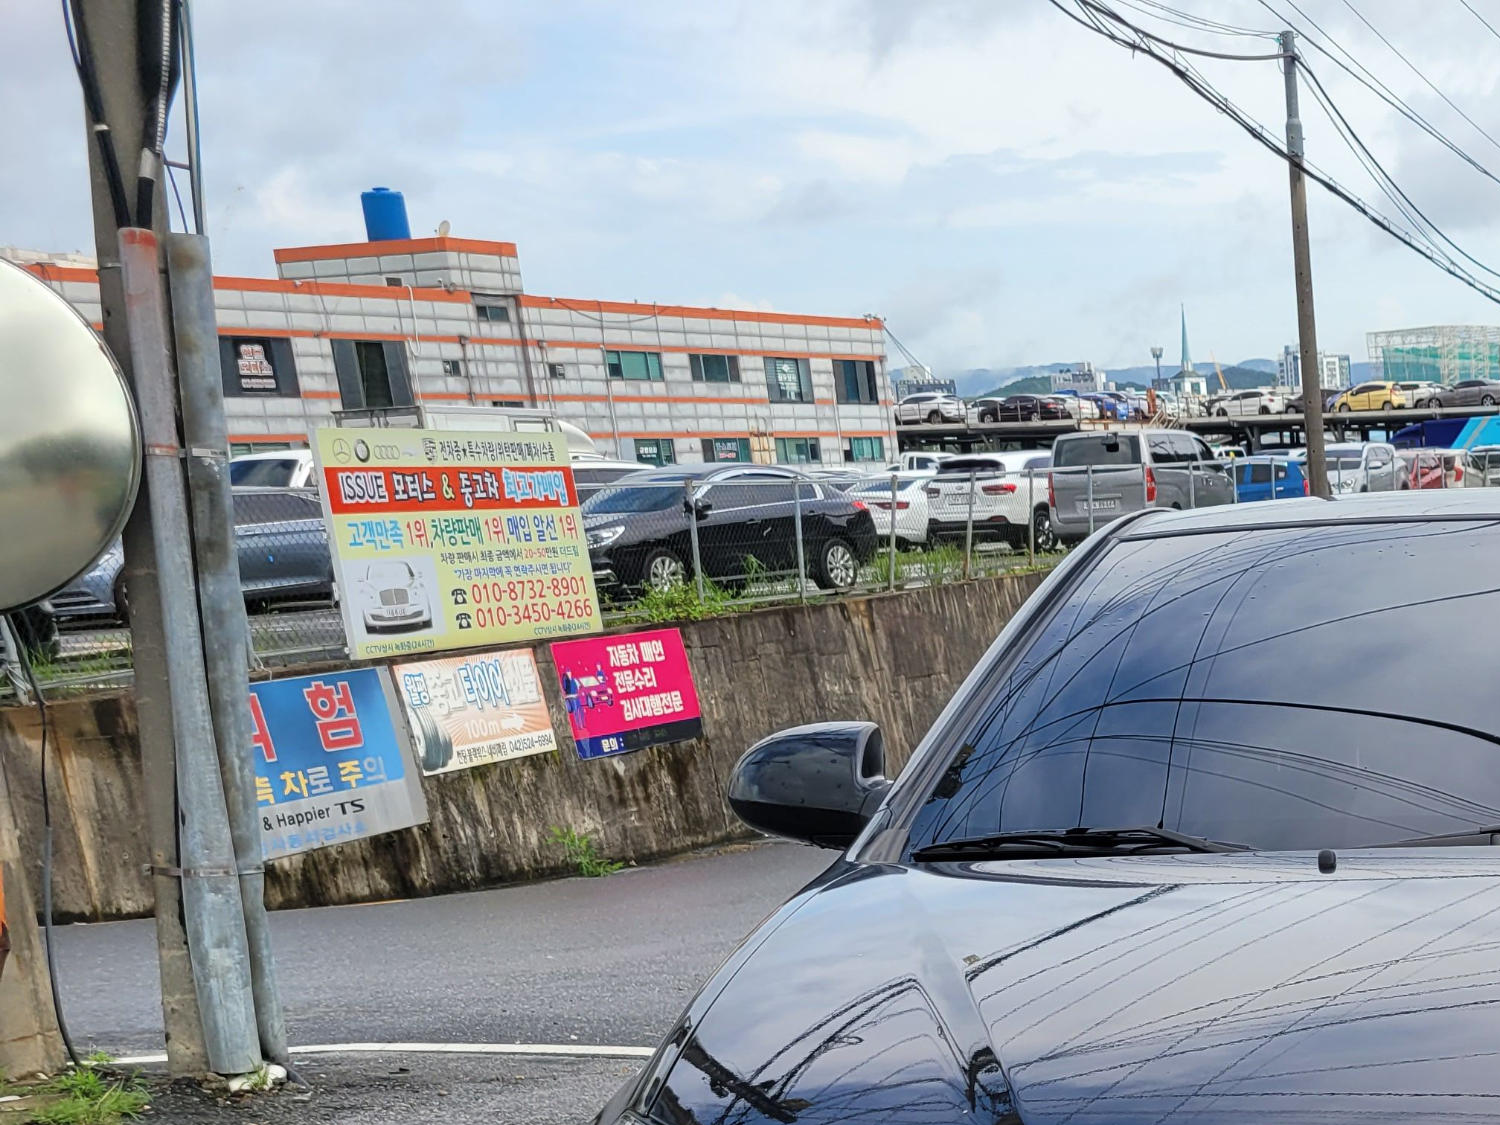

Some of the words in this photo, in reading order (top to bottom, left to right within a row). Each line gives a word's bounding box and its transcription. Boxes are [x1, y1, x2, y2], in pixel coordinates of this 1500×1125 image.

[339, 472, 388, 502] ISSUE
[393, 471, 436, 501] 모터스
[441, 473, 455, 500] &
[459, 472, 499, 507] 중고차
[503, 469, 568, 506] 최고가매입
[347, 519, 403, 550] 고객만족
[533, 513, 558, 541] 알선
[559, 512, 579, 541] 1위
[471, 576, 588, 604] 010-8732-8901
[476, 599, 593, 628] 010-3450-4266
[606, 643, 640, 667] 자동차
[640, 639, 665, 662] 매연
[458, 659, 510, 711] 타이어
[613, 667, 657, 693] 전문수리
[620, 690, 684, 722] 검사대행전문
[465, 719, 500, 739] 100m
[280, 765, 333, 799] 차로
[338, 755, 388, 789] 주의
[262, 816, 274, 831] &
[276, 806, 331, 828] Happier
[334, 798, 366, 816] TS
